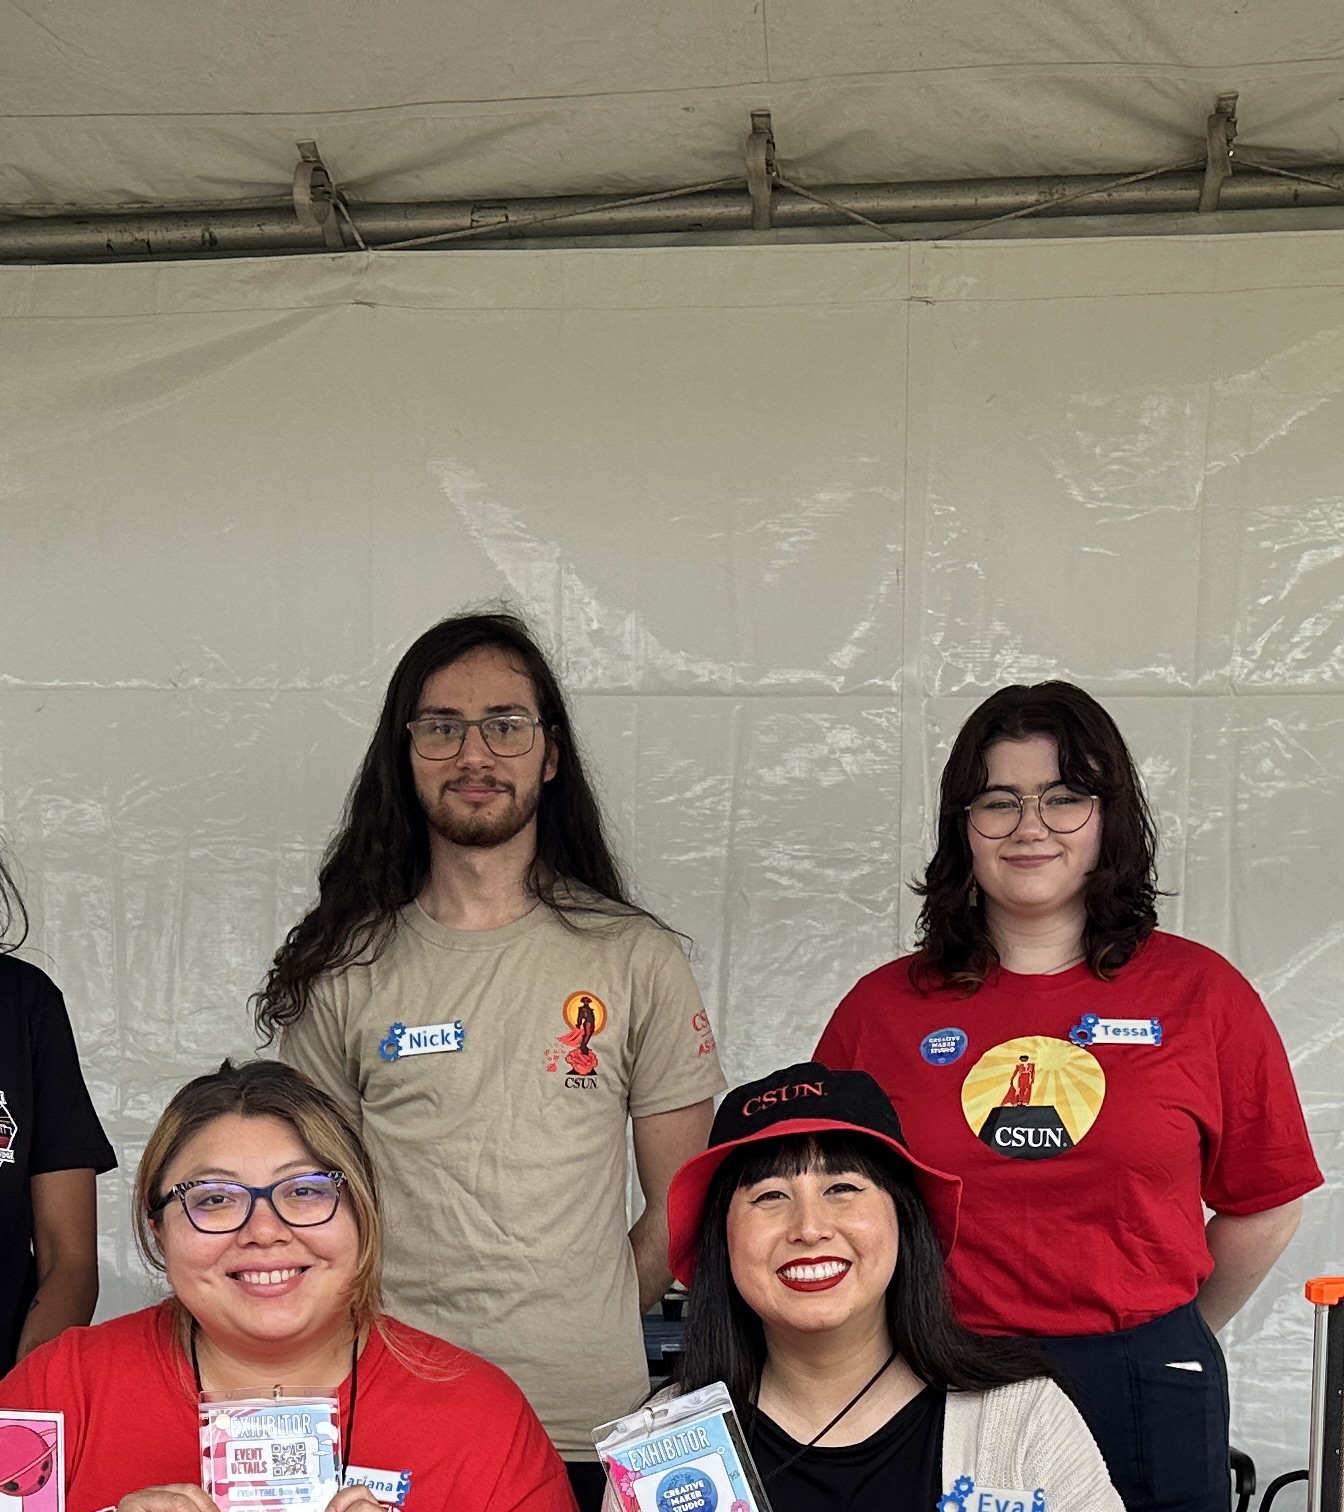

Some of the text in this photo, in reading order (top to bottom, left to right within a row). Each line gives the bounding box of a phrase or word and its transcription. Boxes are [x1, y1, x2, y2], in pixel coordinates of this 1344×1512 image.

[409, 1028, 452, 1049] Nick
[1101, 1024, 1148, 1037] Tessa
[564, 1076, 598, 1089] CSUN
[741, 1081, 825, 1117] CSUN
[995, 1126, 1064, 1148] CSUN
[230, 1413, 312, 1439] EXHIBITOR
[234, 1448, 263, 1462] EVENT
[628, 1427, 711, 1472] EXHIBITOR
[231, 1461, 268, 1475] DETAILS
[663, 1480, 704, 1499] CREATIVE
[670, 1490, 702, 1507] MAKER
